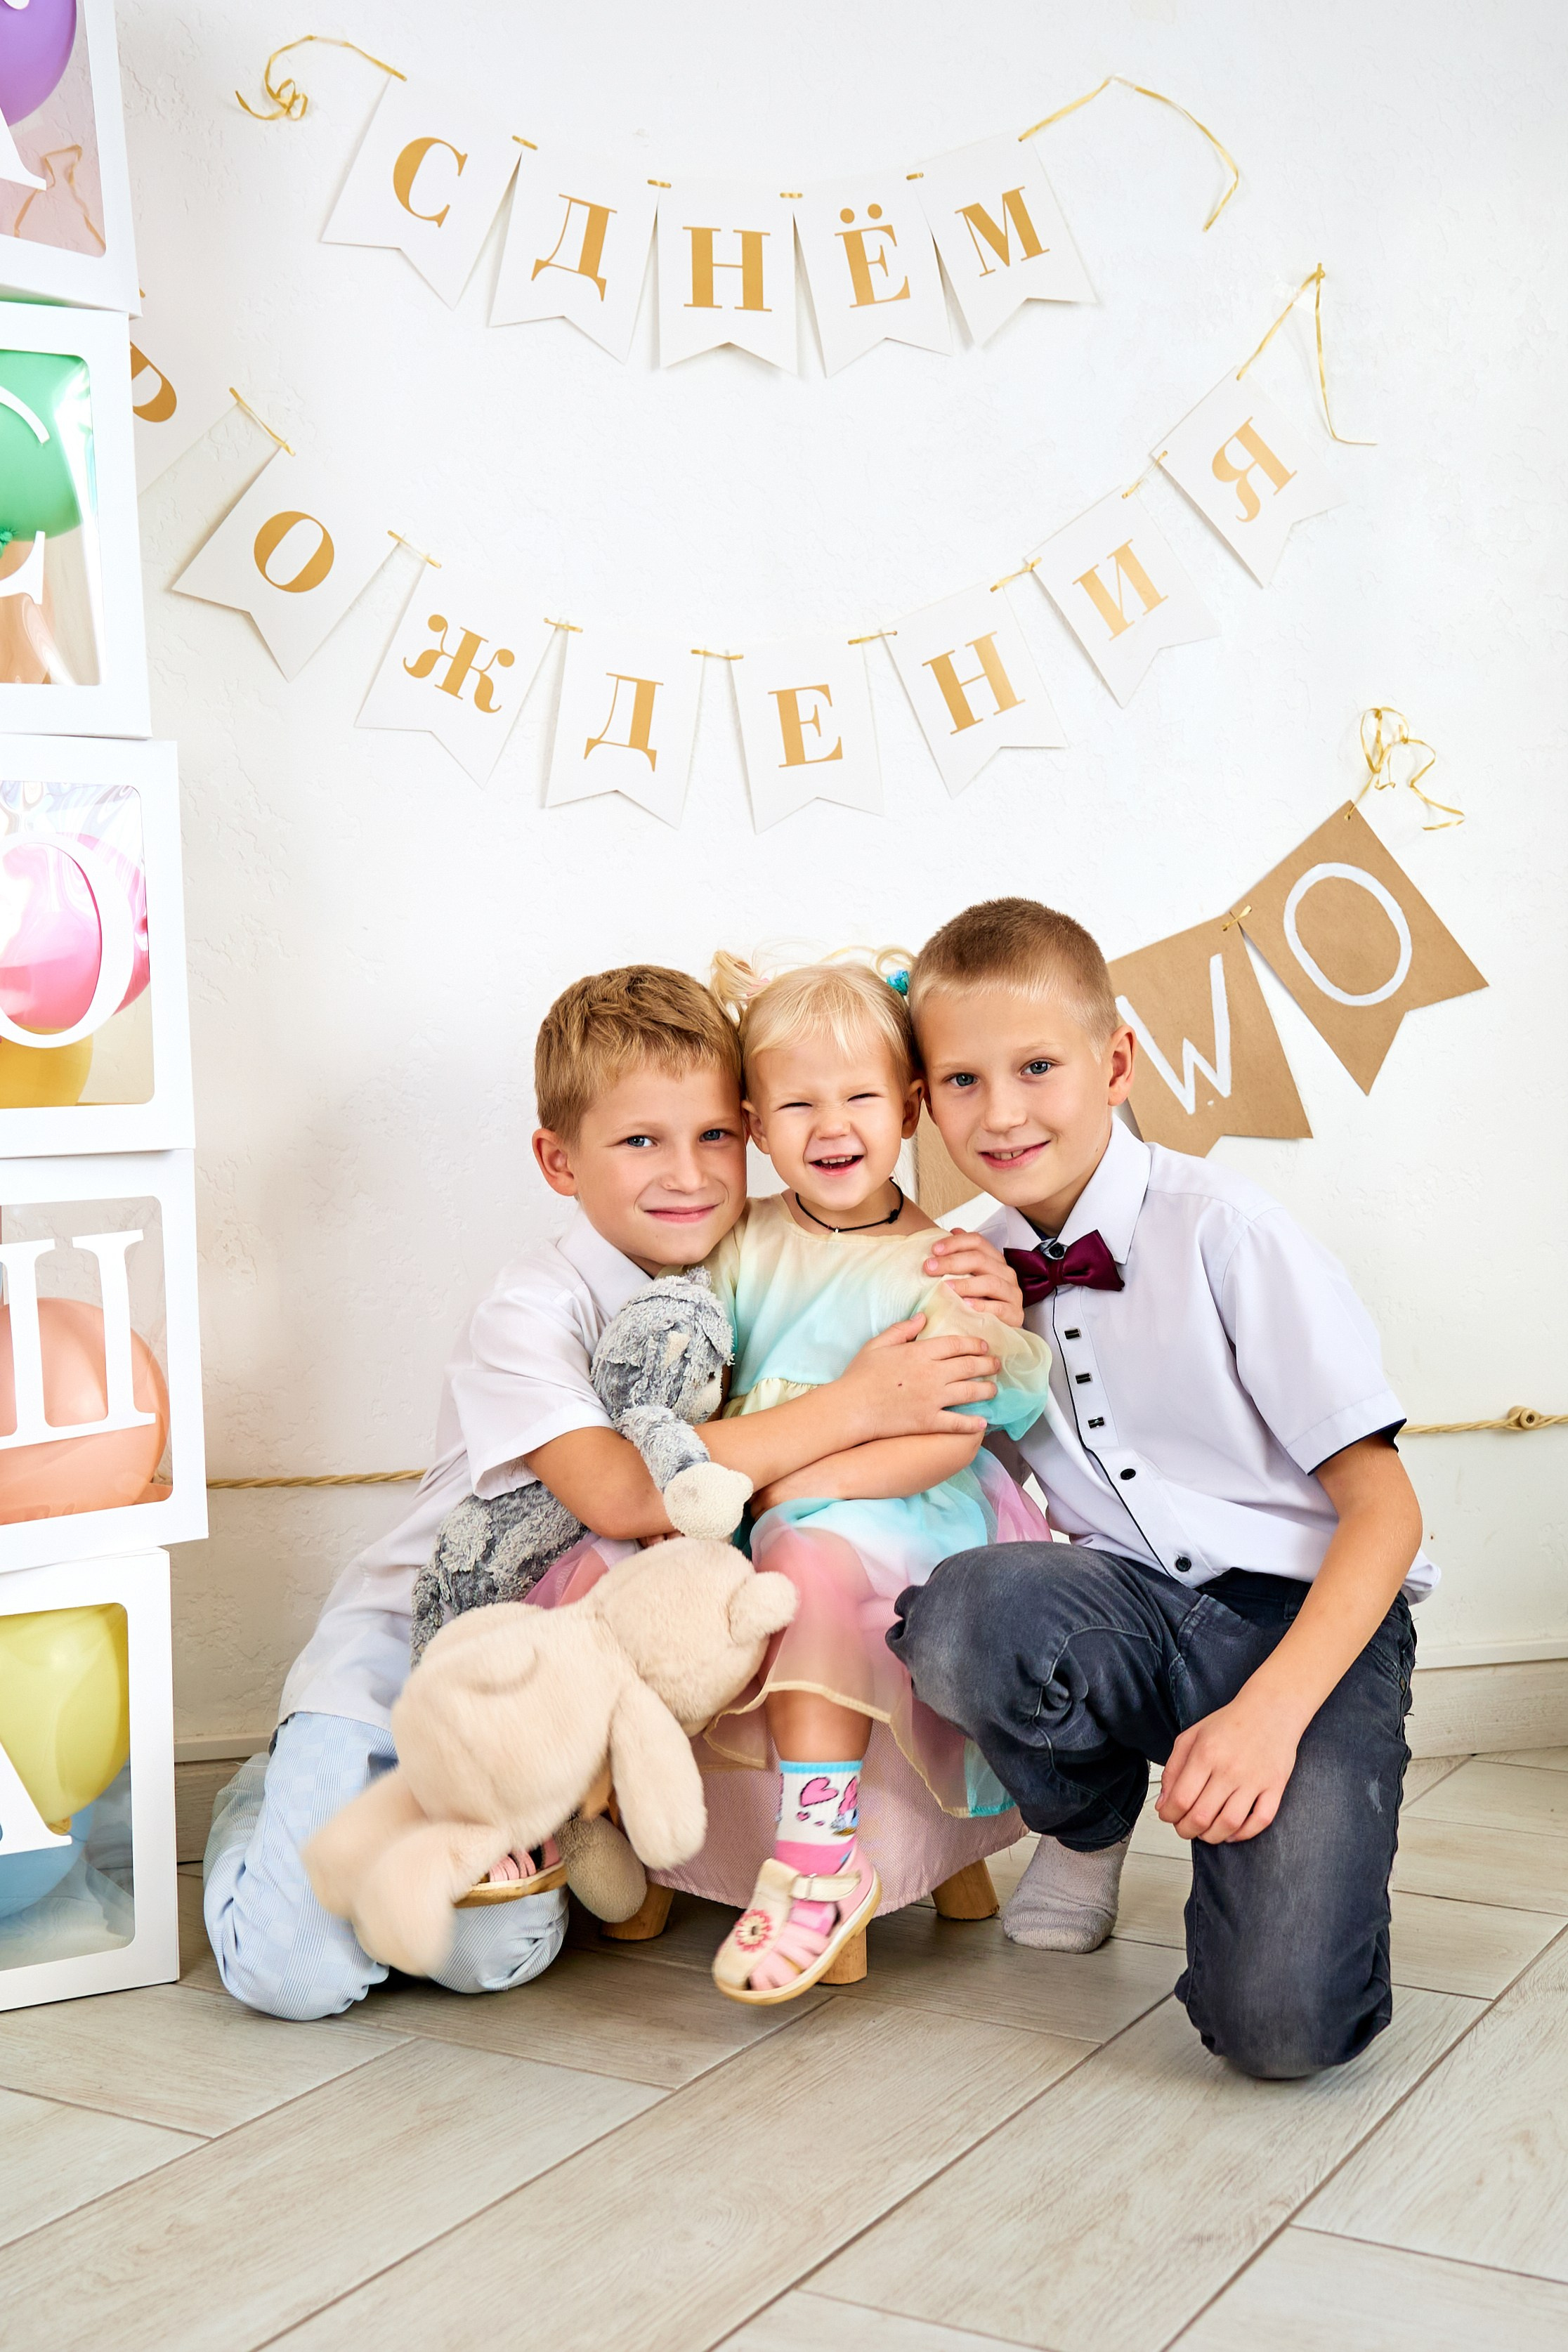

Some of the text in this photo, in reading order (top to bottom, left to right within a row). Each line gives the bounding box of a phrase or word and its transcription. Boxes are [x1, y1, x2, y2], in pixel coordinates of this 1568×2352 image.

[393, 136, 1051, 312] С ДНЁМ
[1116, 862, 1412, 1115] WO
